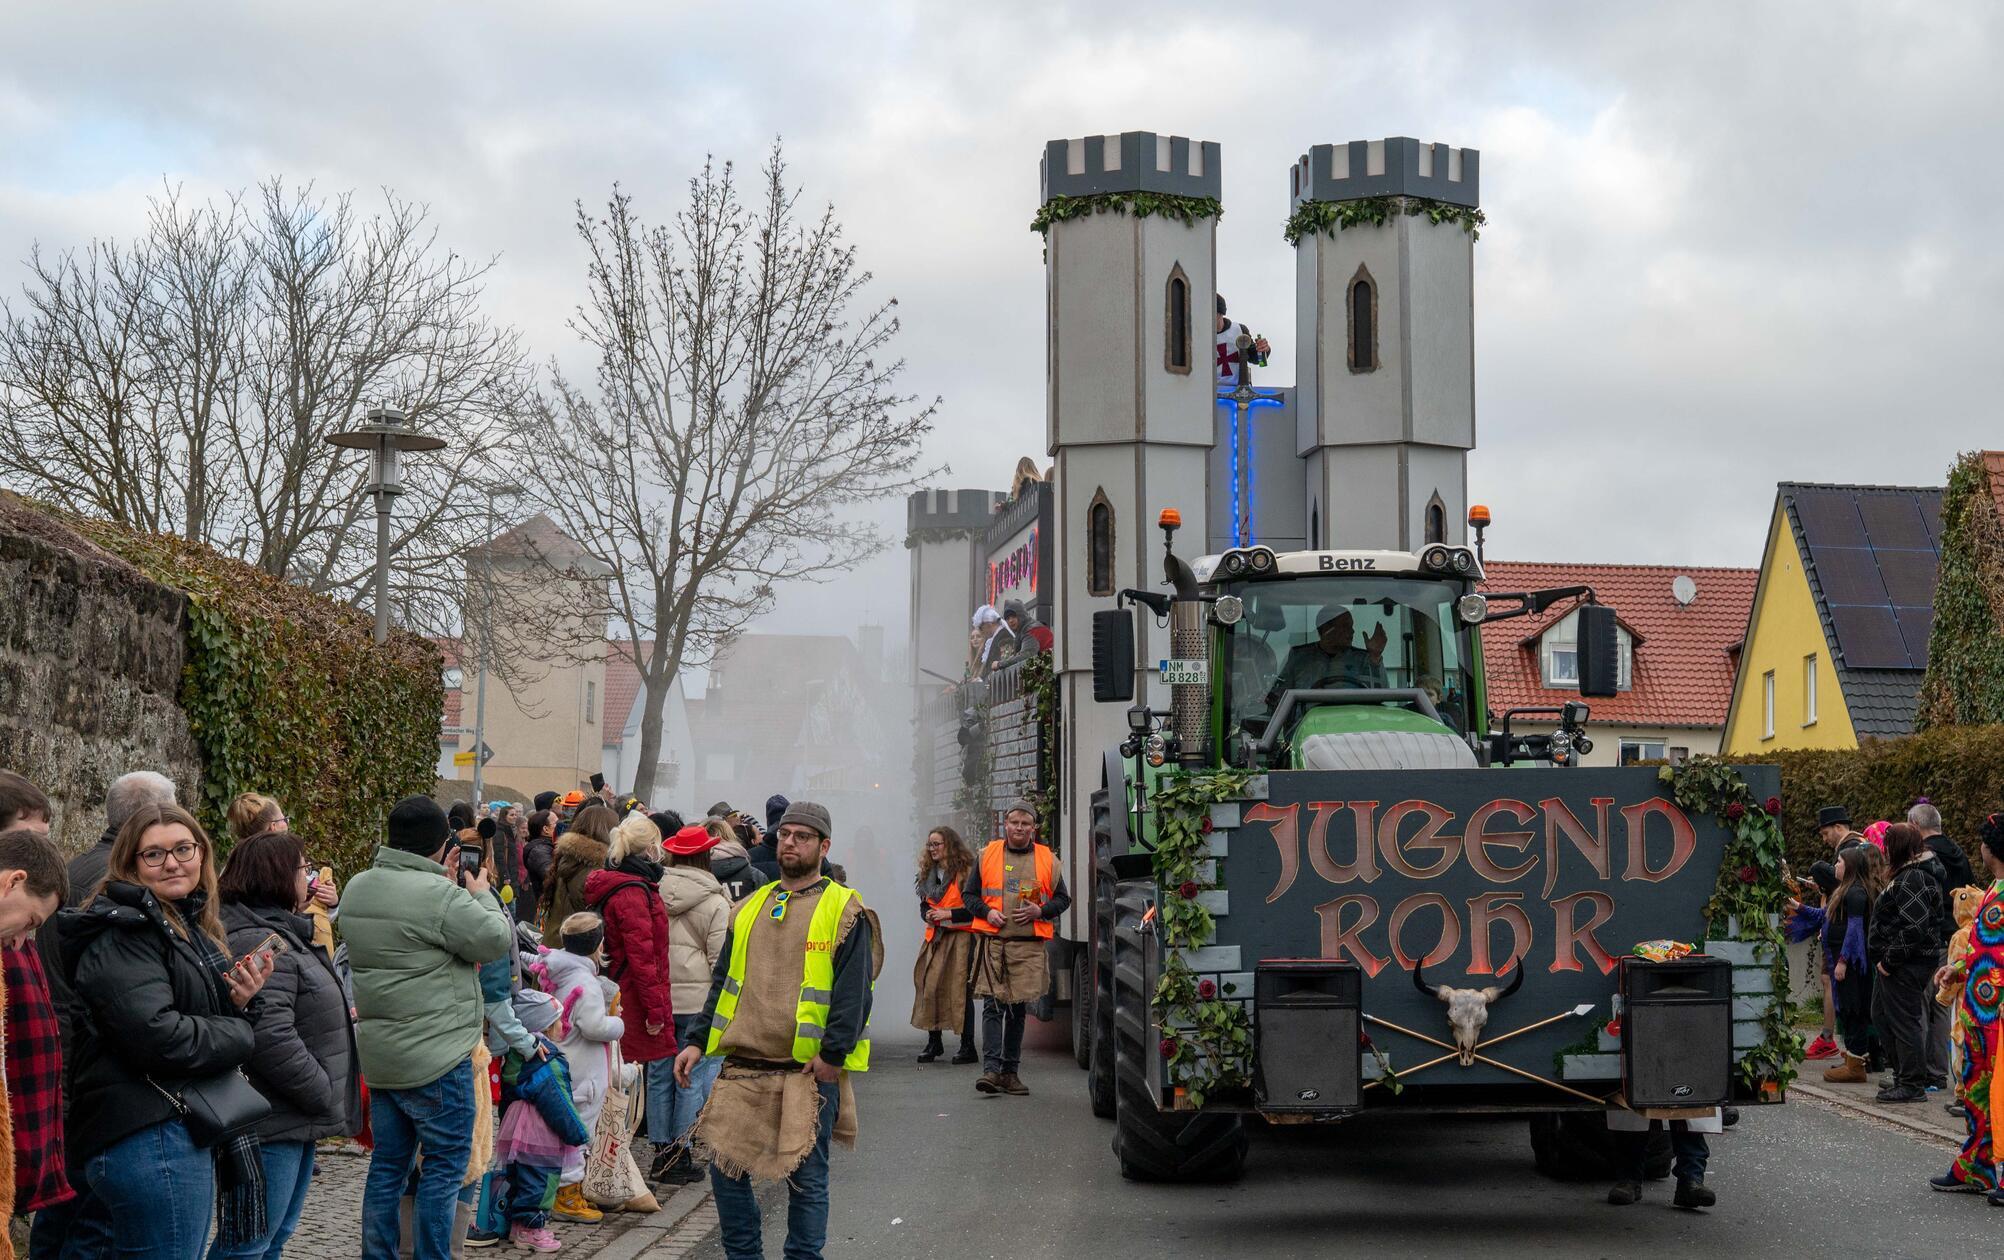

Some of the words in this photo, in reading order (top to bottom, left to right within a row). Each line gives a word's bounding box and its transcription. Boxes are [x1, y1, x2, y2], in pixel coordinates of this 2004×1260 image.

[1319, 555, 1376, 570] Benz
[1168, 661, 1184, 672] NM
[1161, 672, 1176, 683] LB
[1178, 672, 1199, 683] 828
[1243, 796, 1697, 904] JUGEND
[1314, 890, 1620, 979] ROHR
